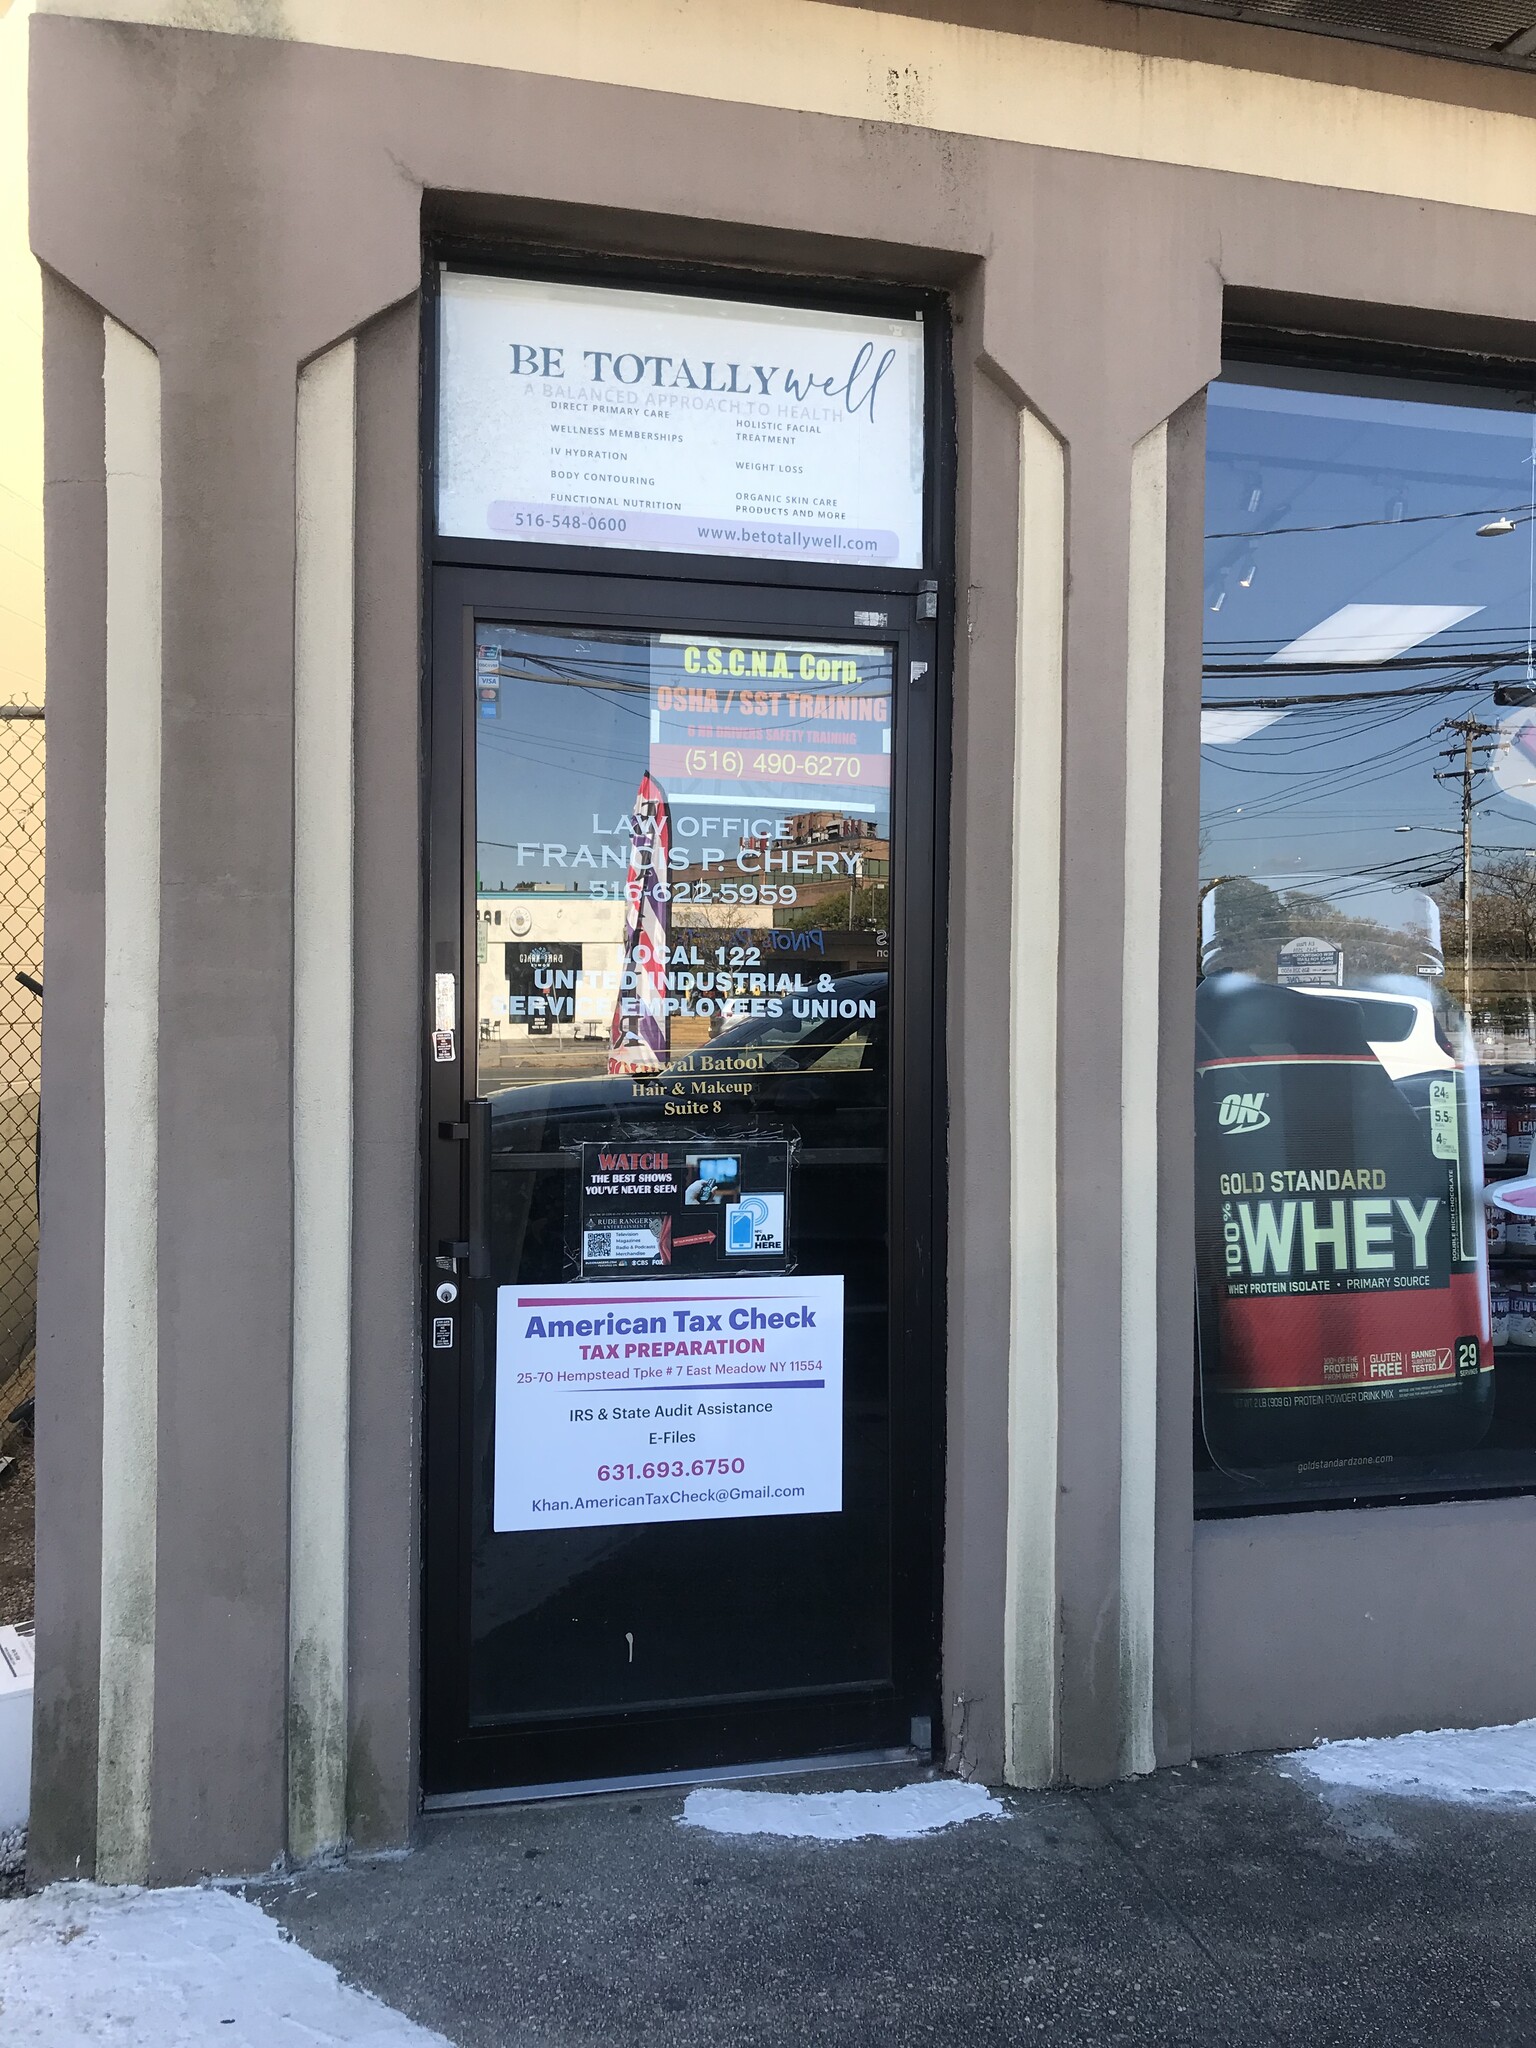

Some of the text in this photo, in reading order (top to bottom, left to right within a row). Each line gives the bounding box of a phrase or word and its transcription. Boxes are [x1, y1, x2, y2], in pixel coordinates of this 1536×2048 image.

[509, 342, 895, 423] BE TOTALLY well
[524, 384, 843, 422] A BALANCED APPROACH TO HEALTH
[551, 401, 670, 419] DIRECT PRIMARY CARE
[550, 424, 684, 443] WELLNESS MEMBERSHIPS
[736, 420, 821, 434] HOLISTIC FACIAL
[736, 433, 795, 445] TREATMENT
[550, 447, 628, 461] IV HYDRATION
[736, 461, 803, 474] WEIGHT LOSS
[550, 470, 655, 486] BODY CONTOURING
[550, 493, 681, 511] FUNCTIONAL NUTRITION
[736, 492, 838, 507] ORGANIC SKIN CARE
[515, 512, 627, 532] 516-548-0600
[736, 505, 846, 520] PRODUCTS AND MORE
[697, 524, 878, 551] www.betotallywell.com
[684, 646, 862, 685] C.S.C.N.A. Corp.
[657, 686, 887, 722] OSHA / SST TRAINING
[766, 729, 804, 743] SAFETY
[807, 731, 856, 745] TRAINING
[685, 749, 861, 778] (516) 490-6270
[593, 814, 793, 840] LAW OFFICE
[516, 843, 864, 874] FRANCIS P. CHERY
[589, 881, 797, 904] 516-622-5959
[617, 945, 760, 965] LOCAL 122
[534, 970, 835, 993] UNITED INDUSTRIAL &
[492, 997, 875, 1019] SERVICE EMPLOYEES UNION
[701, 1053, 764, 1072] Batool
[632, 1080, 752, 1098] Hair & Makeup
[664, 1100, 721, 1116] Suite 8
[1219, 1092, 1268, 1128] ON
[598, 1153, 668, 1170] WATCH
[591, 1174, 672, 1183] THE BEST SHOWS
[1220, 1169, 1386, 1194] GOLD STANDARD
[586, 1185, 677, 1195] YOU'VE NEVER SEEN
[1224, 1202, 1241, 1277] 100%
[1238, 1197, 1441, 1275] WHEY
[1228, 1275, 1429, 1294] WHEY PROTEIN ISOLATE PRIMARY SOURCE
[525, 1306, 816, 1339] American Tax Check
[579, 1338, 765, 1360] TAX PREPARATION
[1369, 1352, 1402, 1363] GLUTEN
[1411, 1350, 1437, 1359] BANNED
[1459, 1344, 1477, 1367] 29
[517, 1360, 823, 1384] 25-70 Hempstead Tpke # 7 East Meadow NY 11554
[1323, 1363, 1359, 1374] PROTEIN
[1324, 1372, 1358, 1381] FROM WHEY
[1370, 1362, 1403, 1377] FREE
[1412, 1364, 1437, 1373] TESTED
[1459, 1368, 1478, 1377] SERVINGS
[1254, 1398, 1258, 1407] 2
[1259, 1398, 1267, 1407] LB
[1294, 1396, 1324, 1405] PROTEIN
[1325, 1394, 1357, 1404] POWDER
[1358, 1392, 1381, 1402] DRINK
[1381, 1390, 1395, 1399] MIX
[570, 1401, 773, 1421] IRS & State Audit Assistance
[649, 1431, 696, 1444] E-Files
[598, 1457, 745, 1481] 631.693.6750
[1297, 1455, 1393, 1474] goldstandardzone.com
[532, 1486, 805, 1512] Khan.AmericanTaxCheck@Gmail.com
